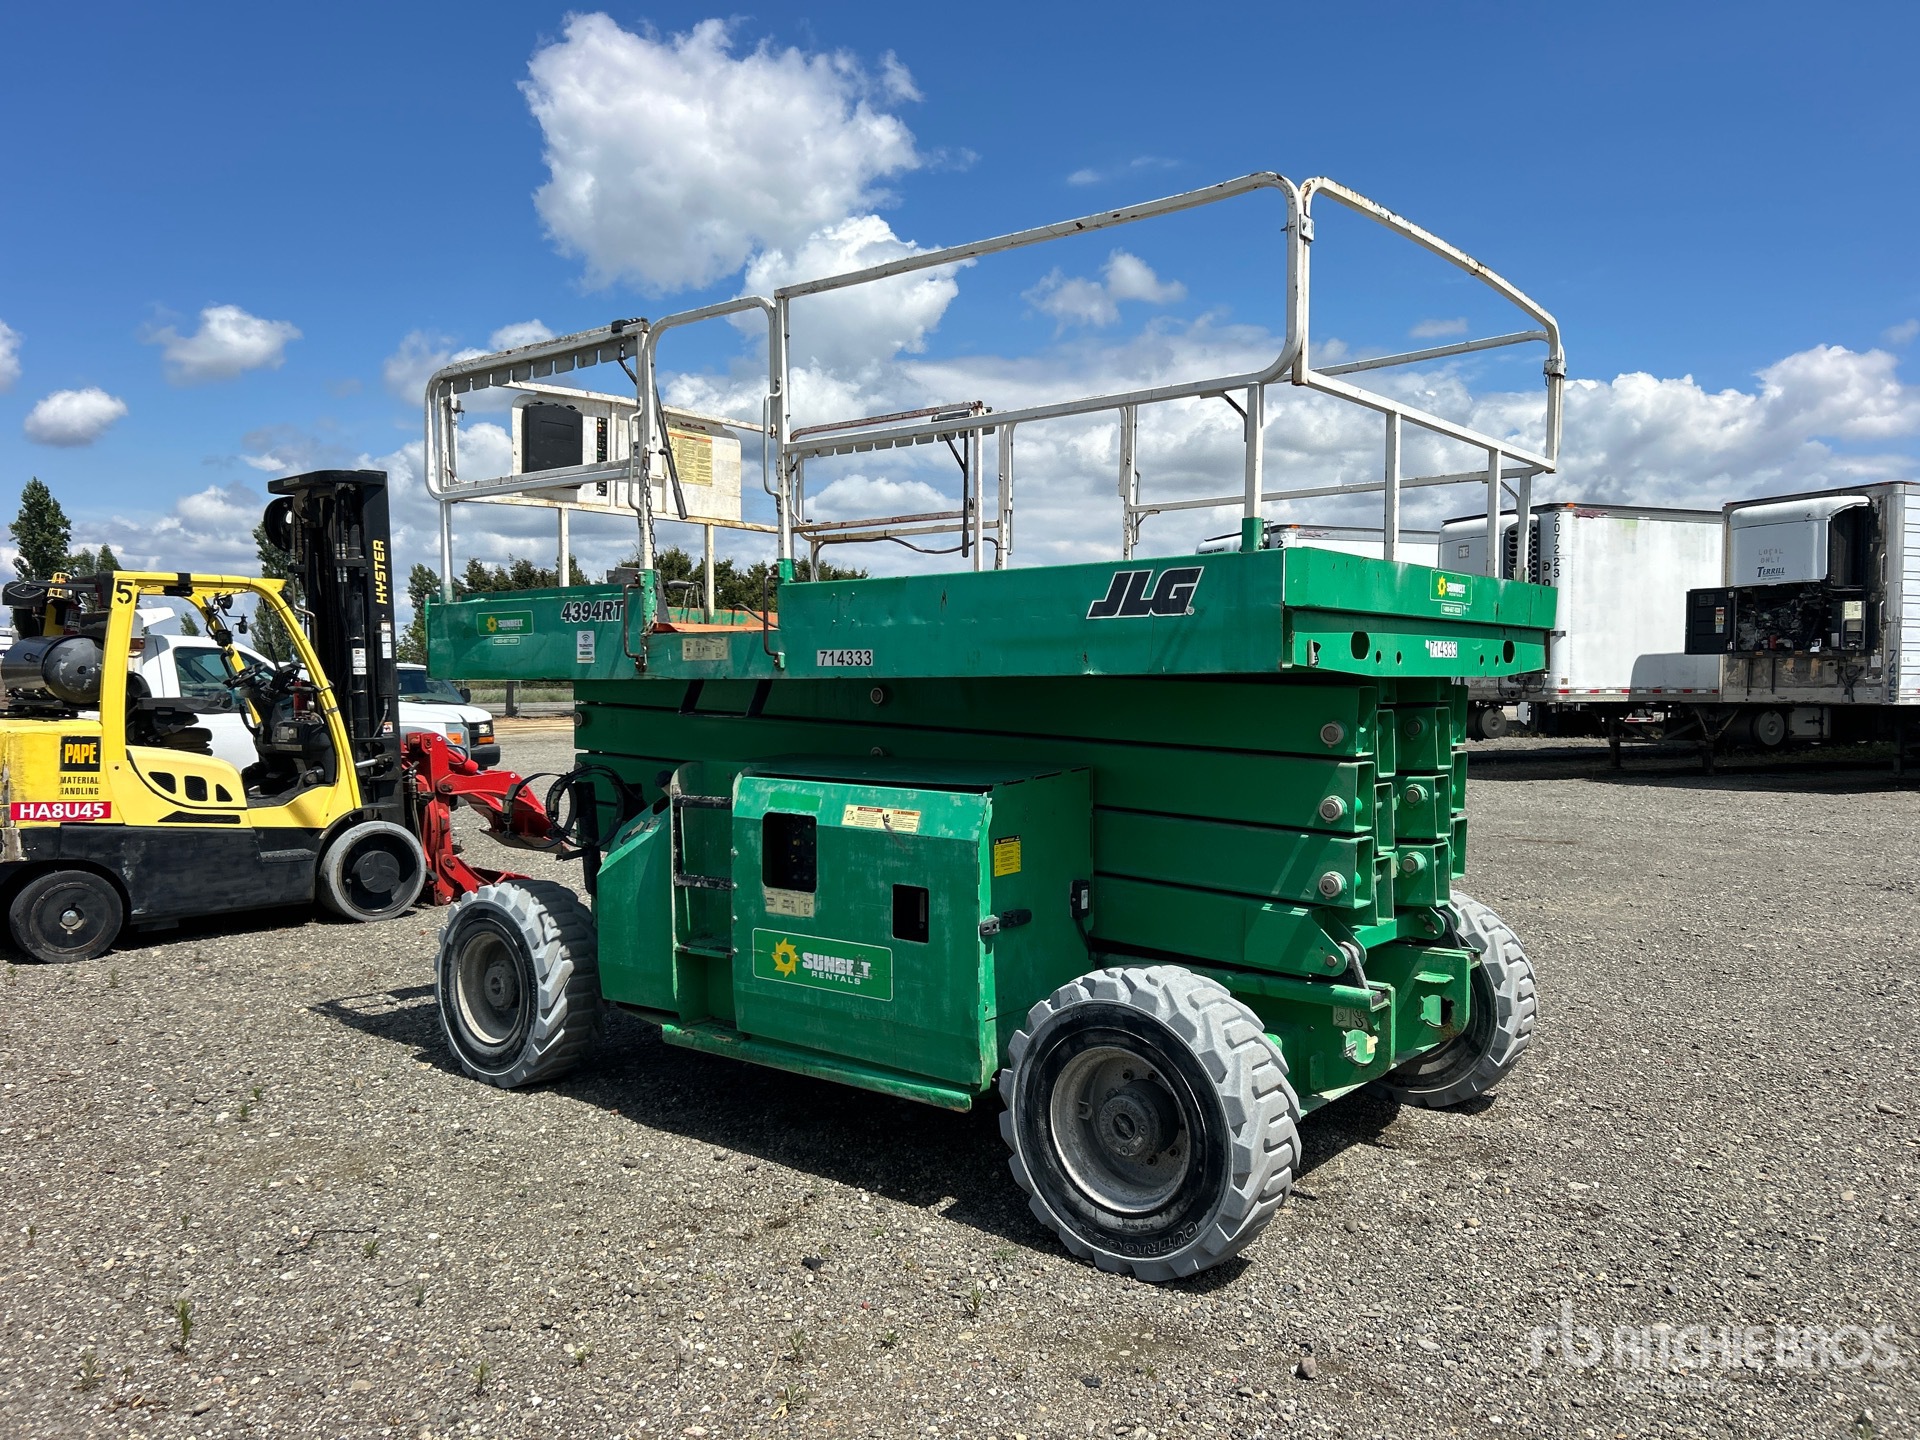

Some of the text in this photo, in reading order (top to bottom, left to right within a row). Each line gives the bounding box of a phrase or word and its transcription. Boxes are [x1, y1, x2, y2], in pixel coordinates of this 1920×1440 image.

[1553, 513, 1561, 578] 207223
[373, 539, 388, 604] HYSTER
[116, 581, 133, 604] 5
[1087, 566, 1204, 619] JLG
[561, 599, 625, 623] 4394RT
[820, 651, 872, 666] 714333
[1430, 641, 1457, 657] 714333
[65, 743, 97, 764] PAPÉ
[20, 803, 104, 819] HA8U45
[811, 971, 861, 985] RENTALS
